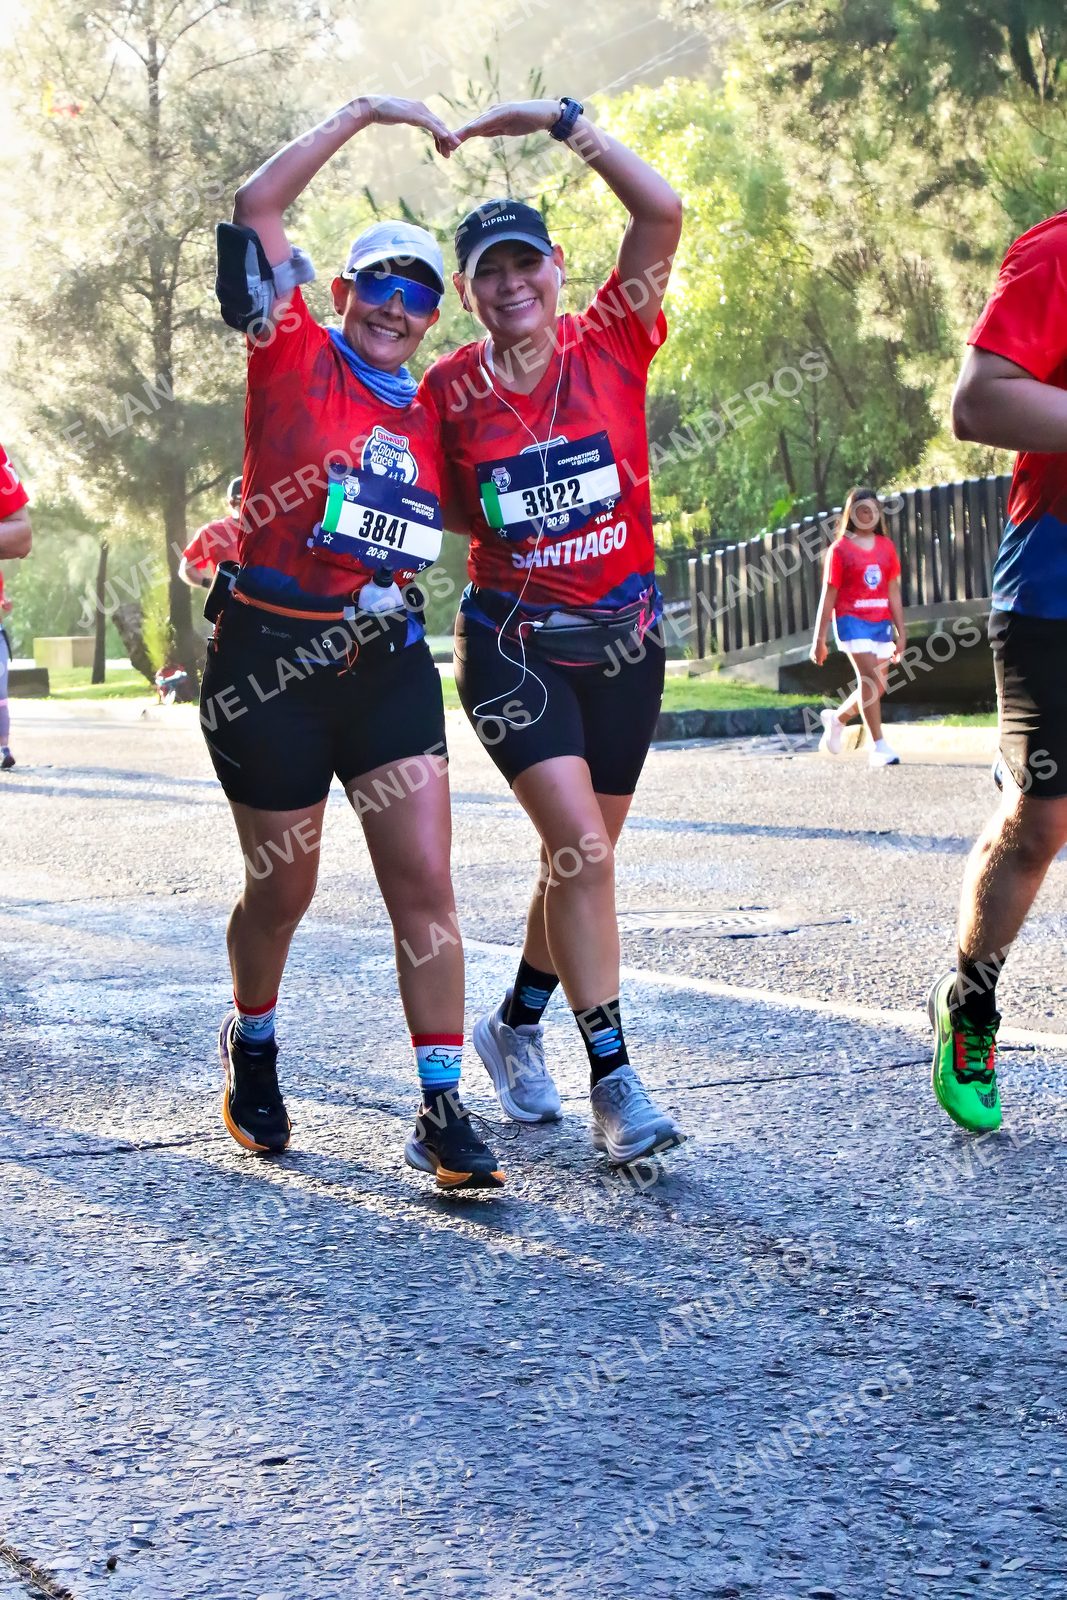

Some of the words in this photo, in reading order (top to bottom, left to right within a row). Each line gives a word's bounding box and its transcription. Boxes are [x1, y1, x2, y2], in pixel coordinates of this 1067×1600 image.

[481, 214, 516, 228] KIPRUN
[371, 451, 394, 467] Race
[378, 444, 404, 462] Global
[522, 479, 584, 517] 3822
[595, 512, 613, 525] 10K
[358, 510, 408, 549] 3841
[511, 521, 628, 569] SANTIAGO
[402, 571, 416, 580] 10
